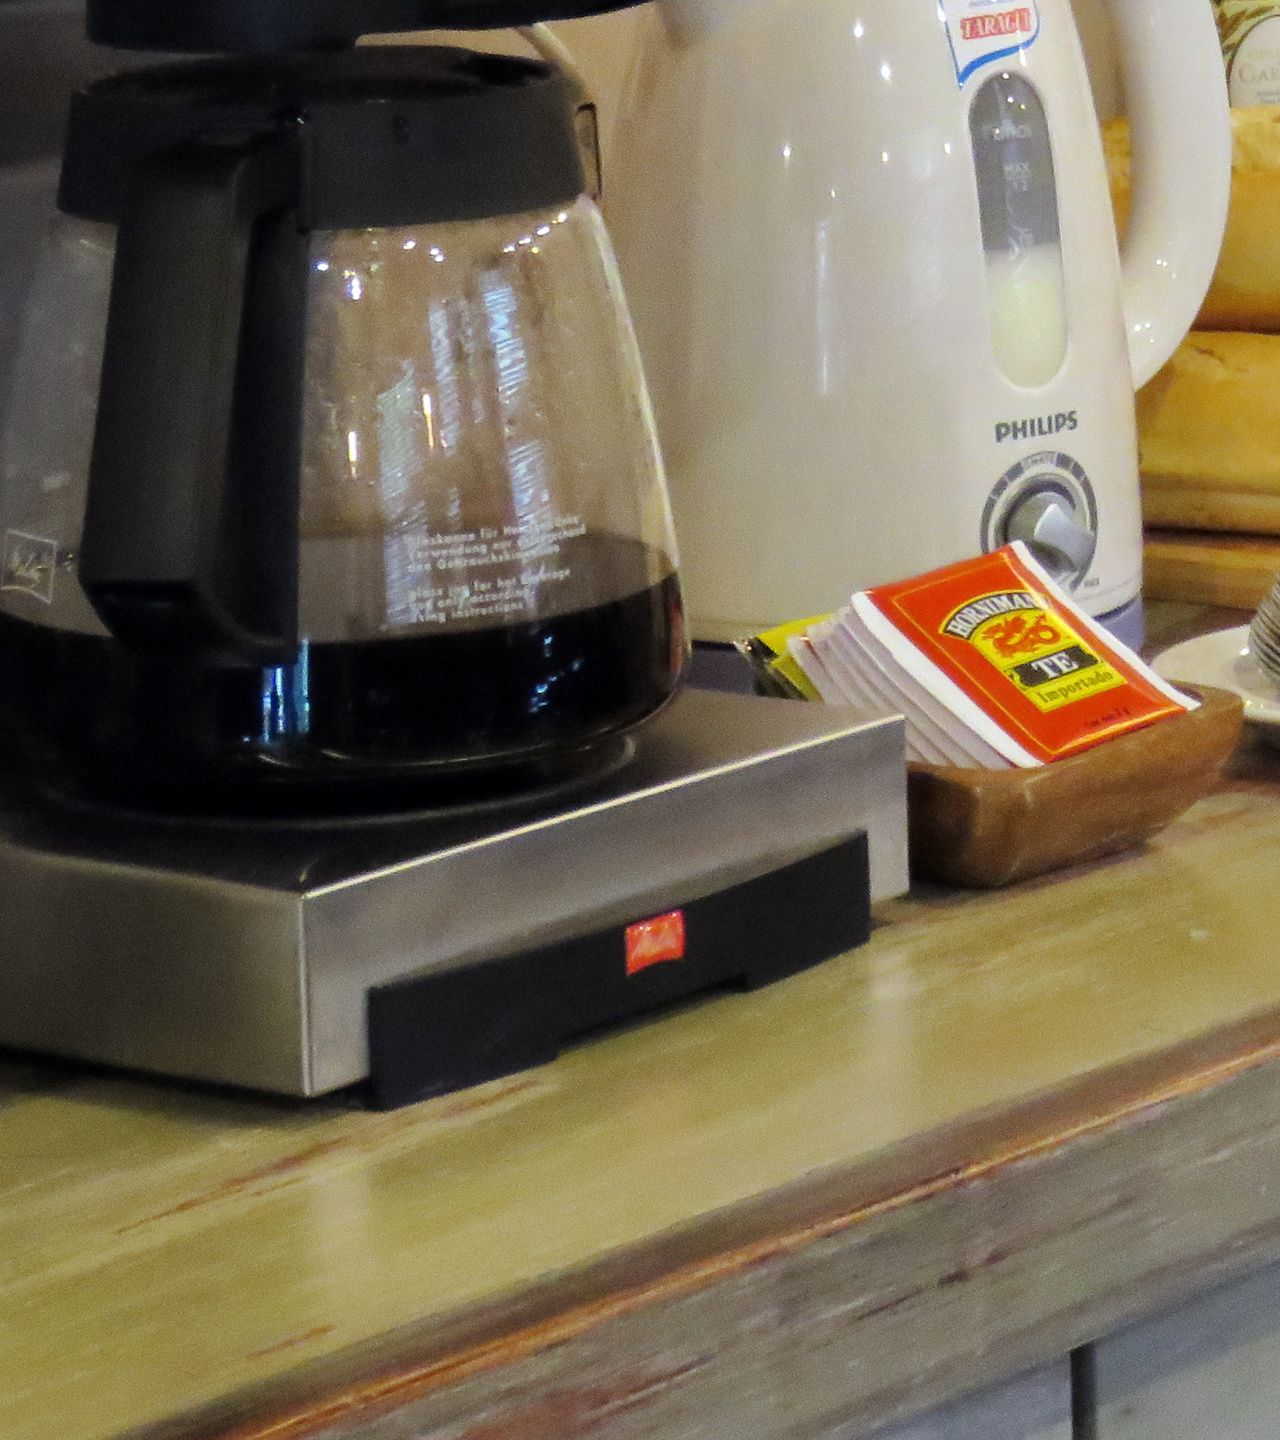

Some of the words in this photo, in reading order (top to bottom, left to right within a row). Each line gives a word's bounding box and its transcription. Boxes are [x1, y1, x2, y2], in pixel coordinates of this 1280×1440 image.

[995, 410, 1078, 443] PHILIPS
[1032, 652, 1079, 679] TE
[1038, 671, 1114, 702] Importado
